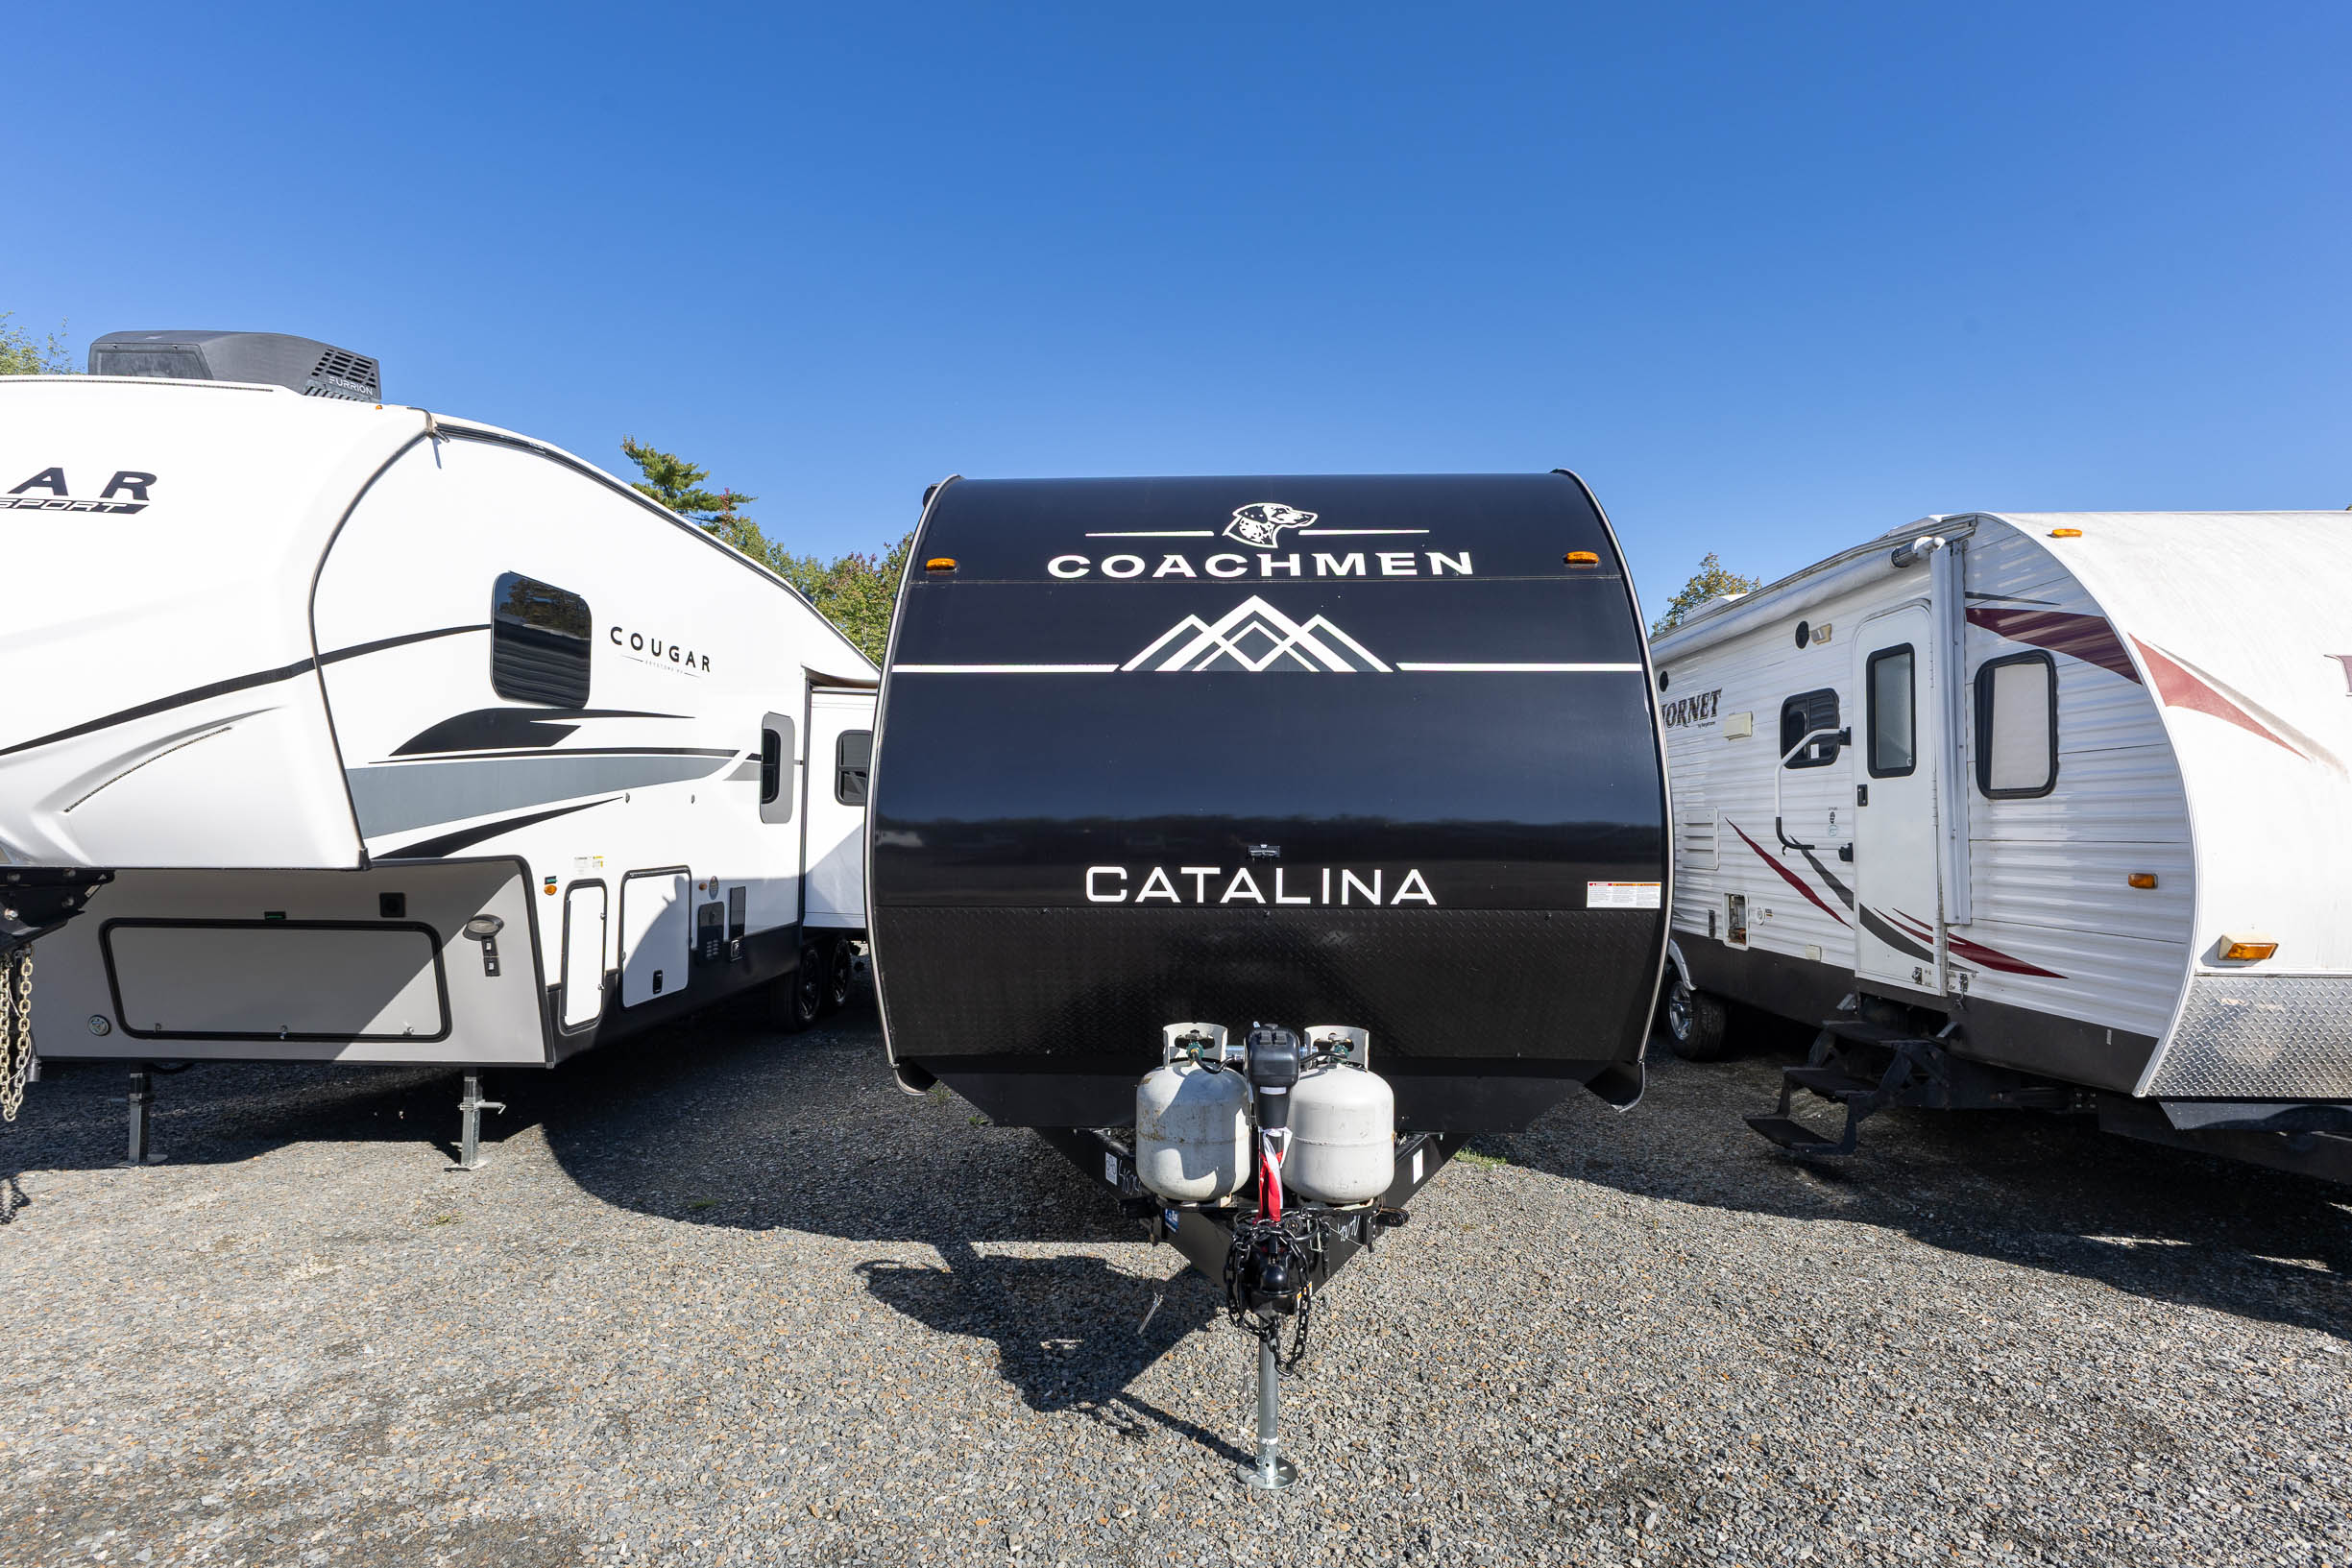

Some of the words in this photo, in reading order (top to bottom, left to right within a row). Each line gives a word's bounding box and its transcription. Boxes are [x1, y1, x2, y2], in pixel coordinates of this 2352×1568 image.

[328, 375, 373, 396] FURRION
[1047, 551, 1474, 579] COACHMEN
[610, 626, 711, 673] COUGAR
[1085, 866, 1438, 905] CATALINA
